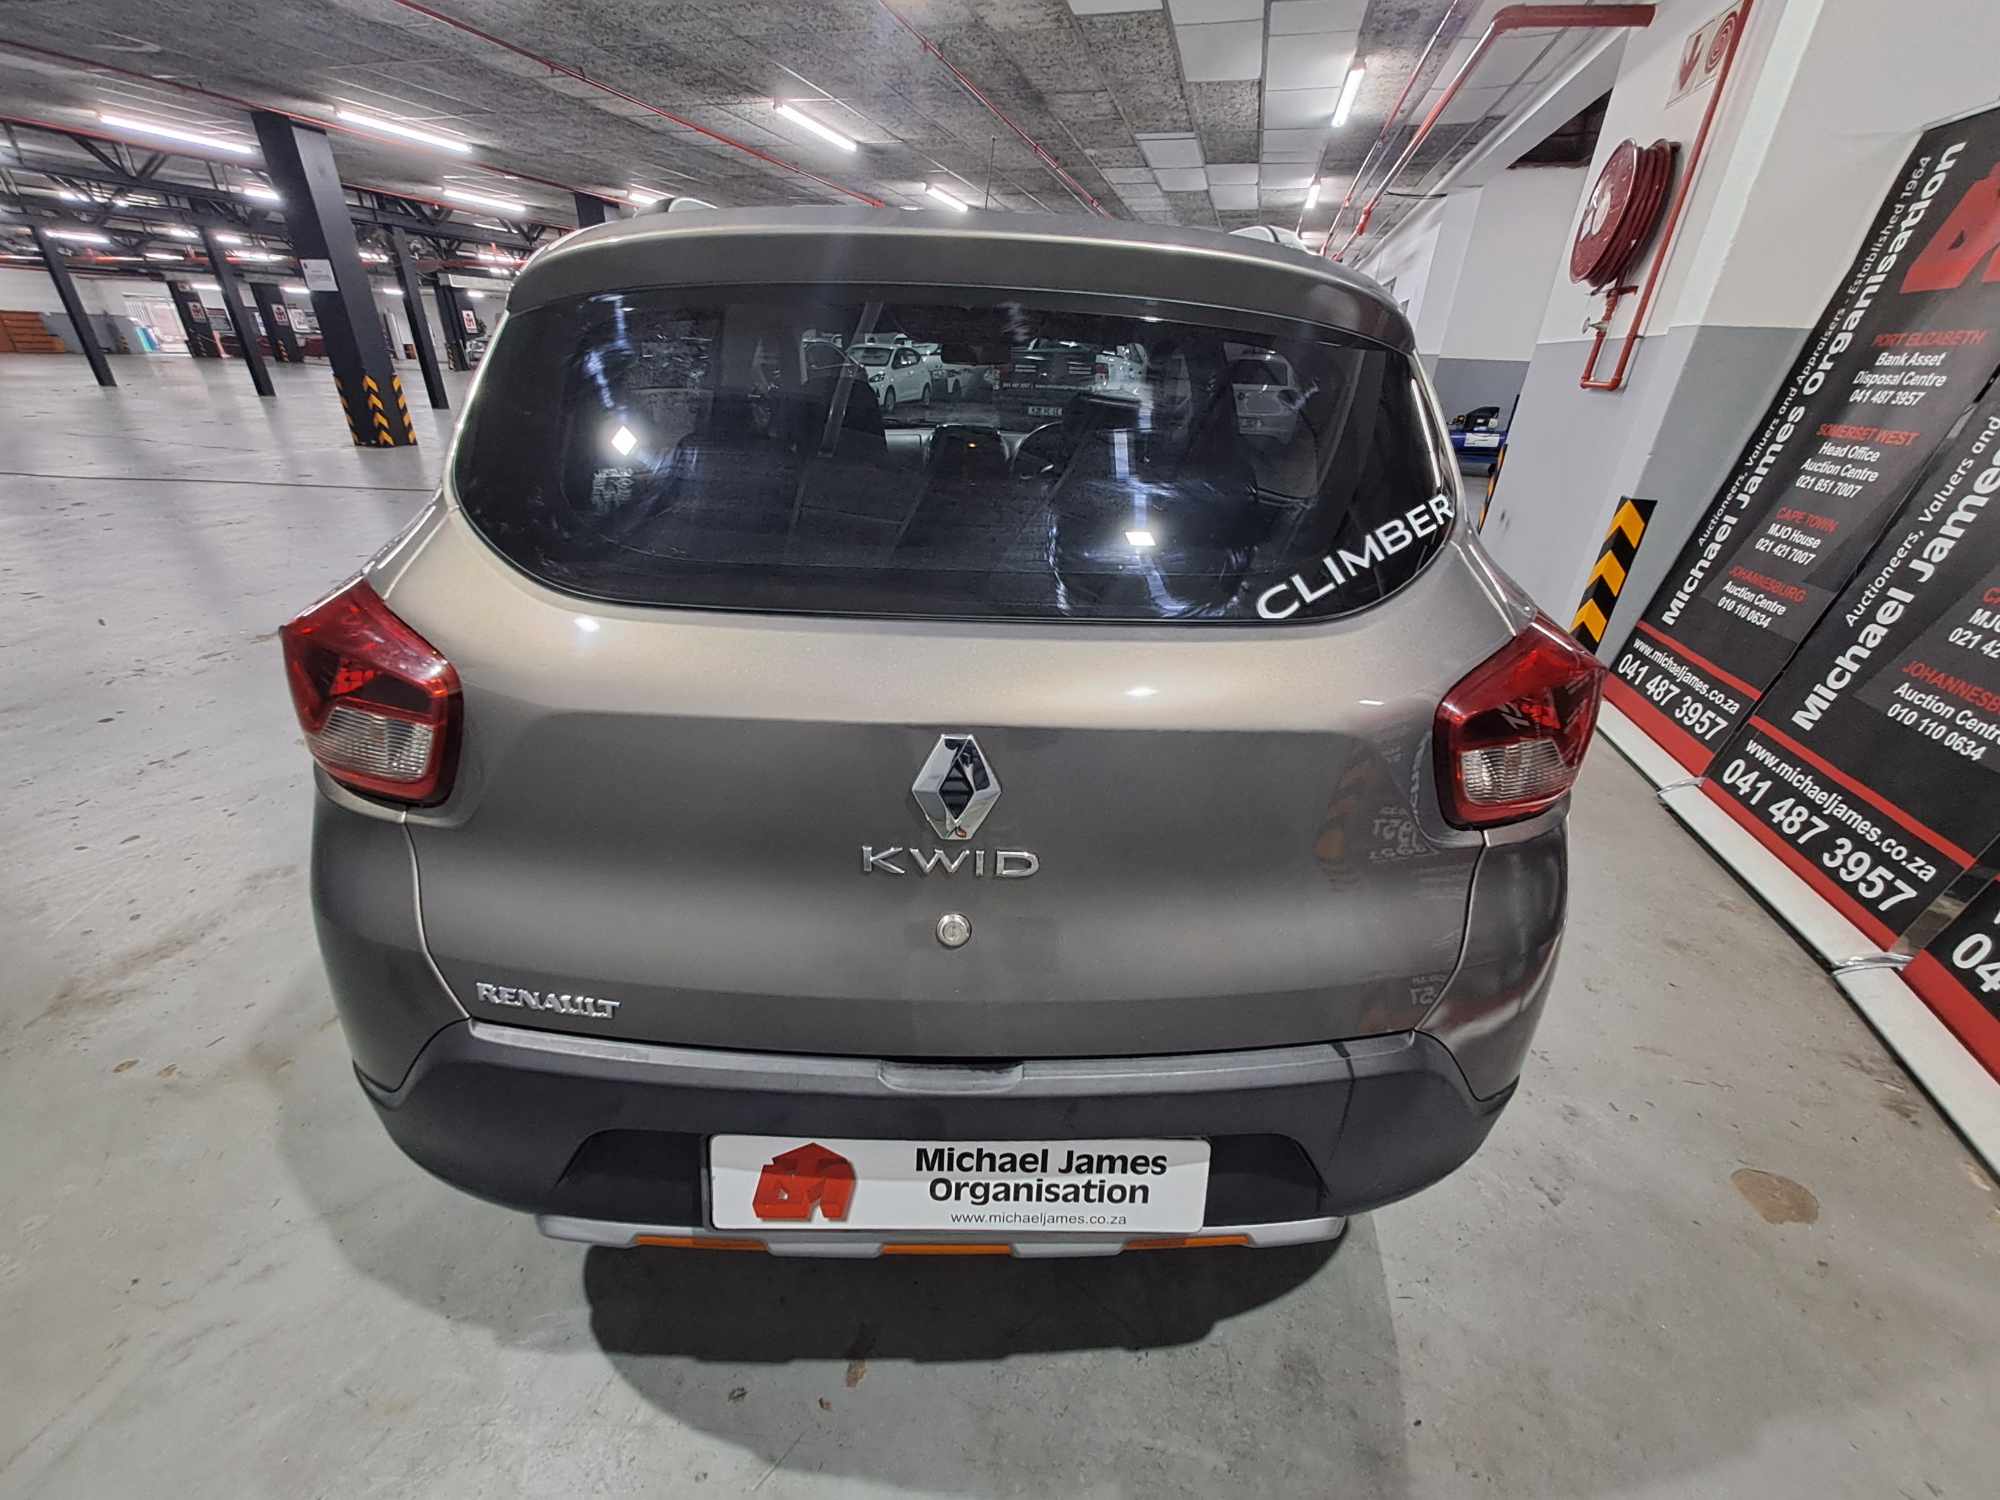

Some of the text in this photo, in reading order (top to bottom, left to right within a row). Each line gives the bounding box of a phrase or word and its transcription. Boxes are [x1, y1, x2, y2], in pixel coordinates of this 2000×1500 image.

[1745, 418, 1779, 466] Valuers
[1779, 387, 1798, 414] and
[1796, 308, 1846, 385] Appraisers
[1848, 204, 1906, 294] Established
[1901, 156, 1932, 198] 1964
[1873, 329, 1988, 347] PORT ELIZABETH
[1875, 352, 1947, 366] Bank Asset
[1661, 142, 1967, 626] Michael James Organisation
[1852, 370, 1948, 387] Disposal Centre
[1849, 389, 1927, 406] 041 487 3957
[1816, 423, 1920, 446] SOMERSET WEST
[1819, 441, 1881, 462] Head Office
[1800, 458, 1879, 482] Auction Centre
[1795, 475, 1863, 498] 021 851 7007
[1776, 506, 1839, 534] CAPE TOWN
[1844, 416, 2000, 628] Auctioneers, Valuers and
[1768, 523, 1822, 549] MJO House
[1256, 493, 1455, 619] CLIMBER
[1755, 538, 1817, 566] 021 421 7007
[1717, 597, 1773, 629] 010 110 0634
[1722, 581, 1787, 616] Auction Centre
[1948, 627, 1982, 649] 021
[1791, 587, 1915, 732] Michael
[1633, 638, 1740, 715] www.michaeljames.co.za
[1618, 653, 1729, 740] 041 487 3957
[1893, 682, 1955, 719] Auction
[1887, 703, 1987, 761] 010 110 0634
[1745, 738, 1938, 882] www.michaeljames.co.za
[1722, 759, 1918, 912] 041 487 3957
[862, 845, 1040, 878] KWID
[475, 982, 621, 1019] RENAULT
[915, 1147, 1168, 1175] Michael James
[929, 1177, 1150, 1206] Organisation
[950, 1212, 1127, 1226] www.michaeljames.co.za
